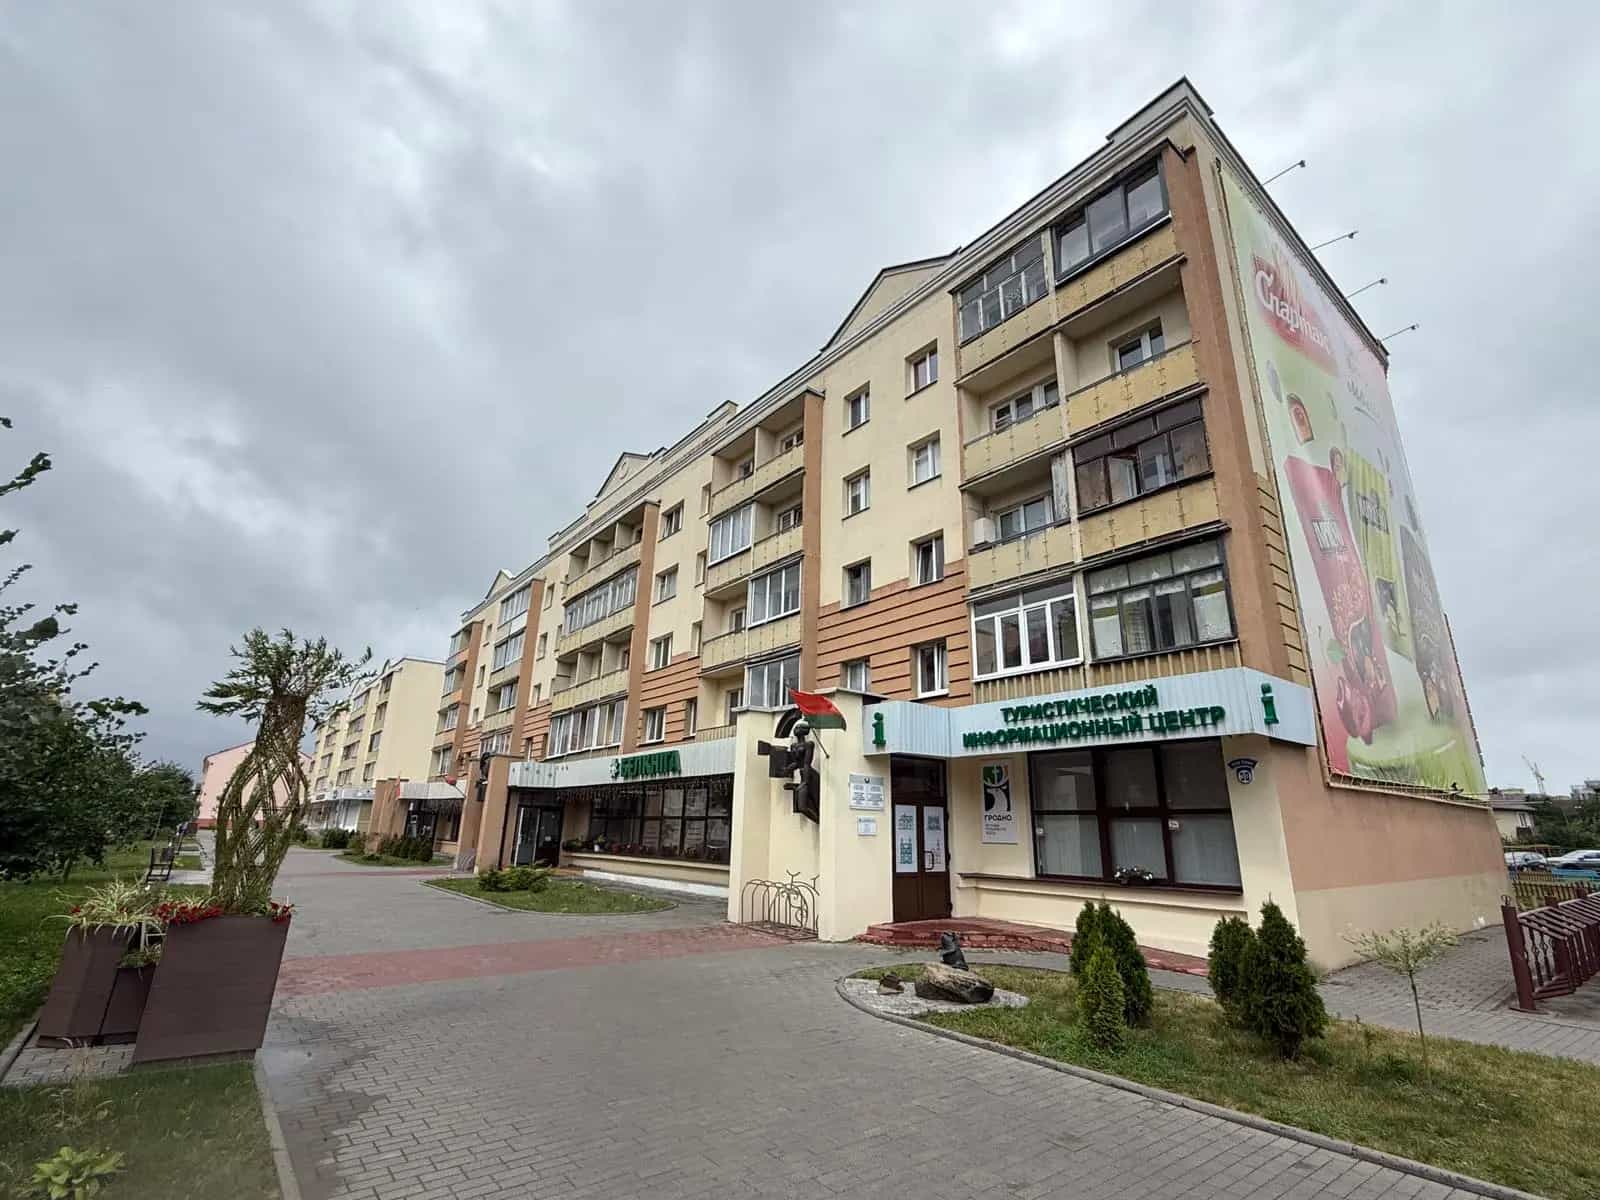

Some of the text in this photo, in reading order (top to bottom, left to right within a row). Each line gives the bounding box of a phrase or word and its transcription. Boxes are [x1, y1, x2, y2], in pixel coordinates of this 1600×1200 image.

[1000, 684, 1159, 723] ТУРИСТИЧЕСКИЙ
[962, 705, 1226, 748] ИНФОРМАЦИОННЫЙ ЦЕНТР
[984, 813, 1013, 822] ГРОДНО
